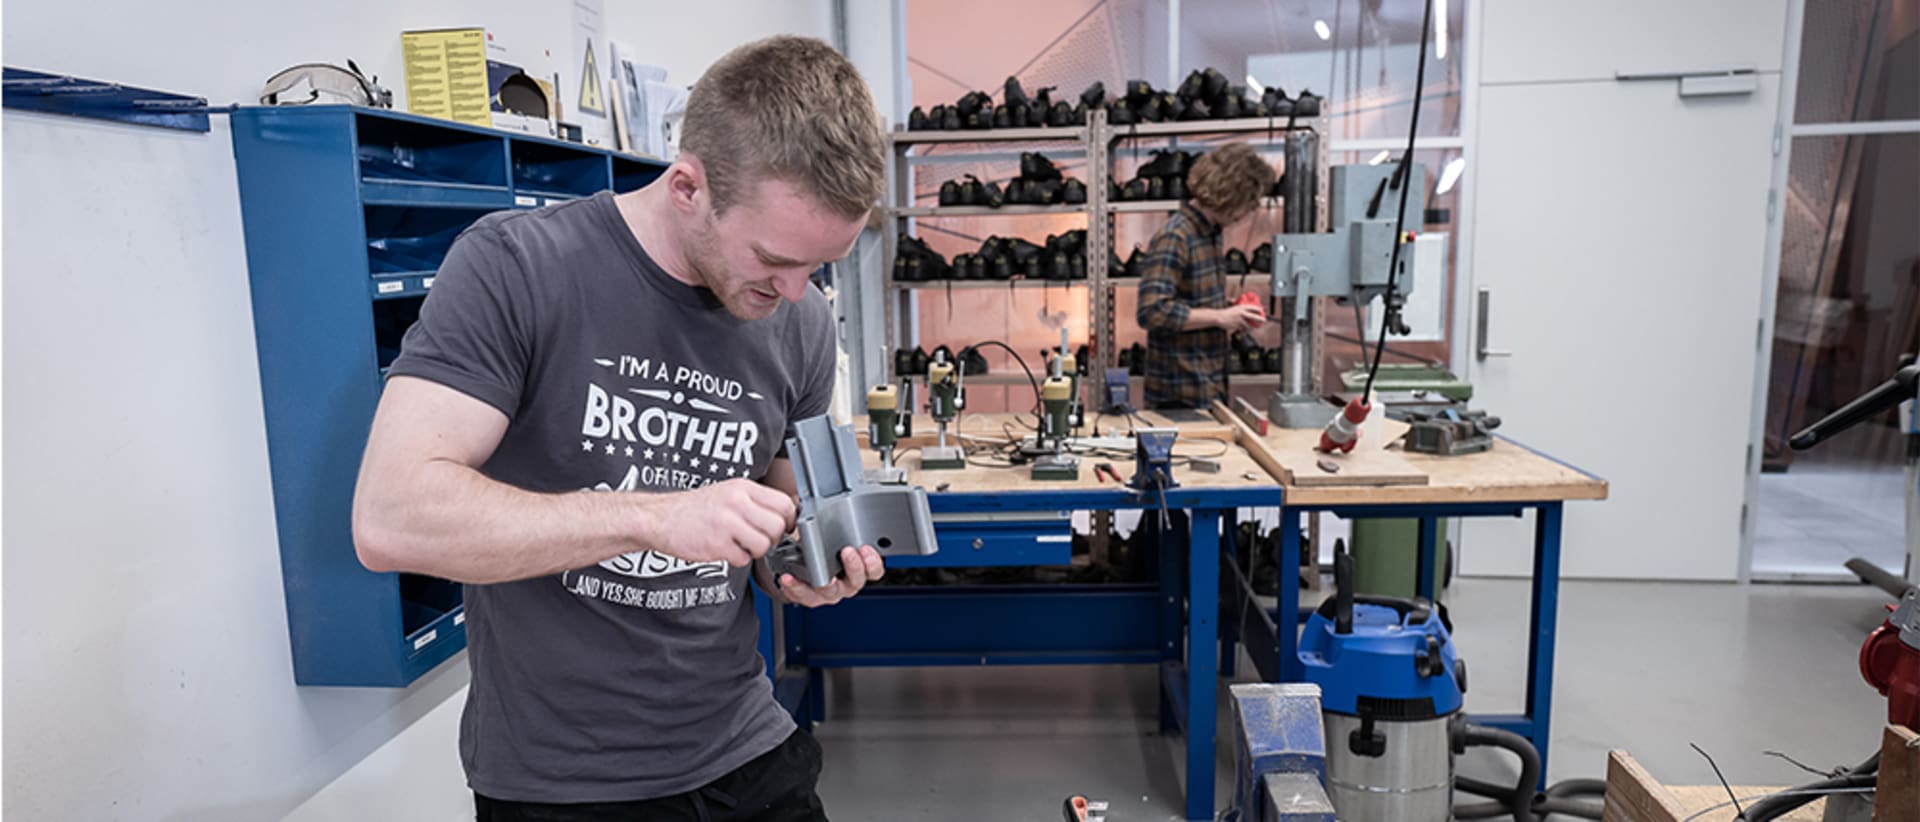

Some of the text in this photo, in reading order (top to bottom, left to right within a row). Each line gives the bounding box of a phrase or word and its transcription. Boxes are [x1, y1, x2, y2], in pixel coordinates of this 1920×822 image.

[619, 355, 743, 400] I'M A PROUD
[582, 383, 758, 465] BROTHER
